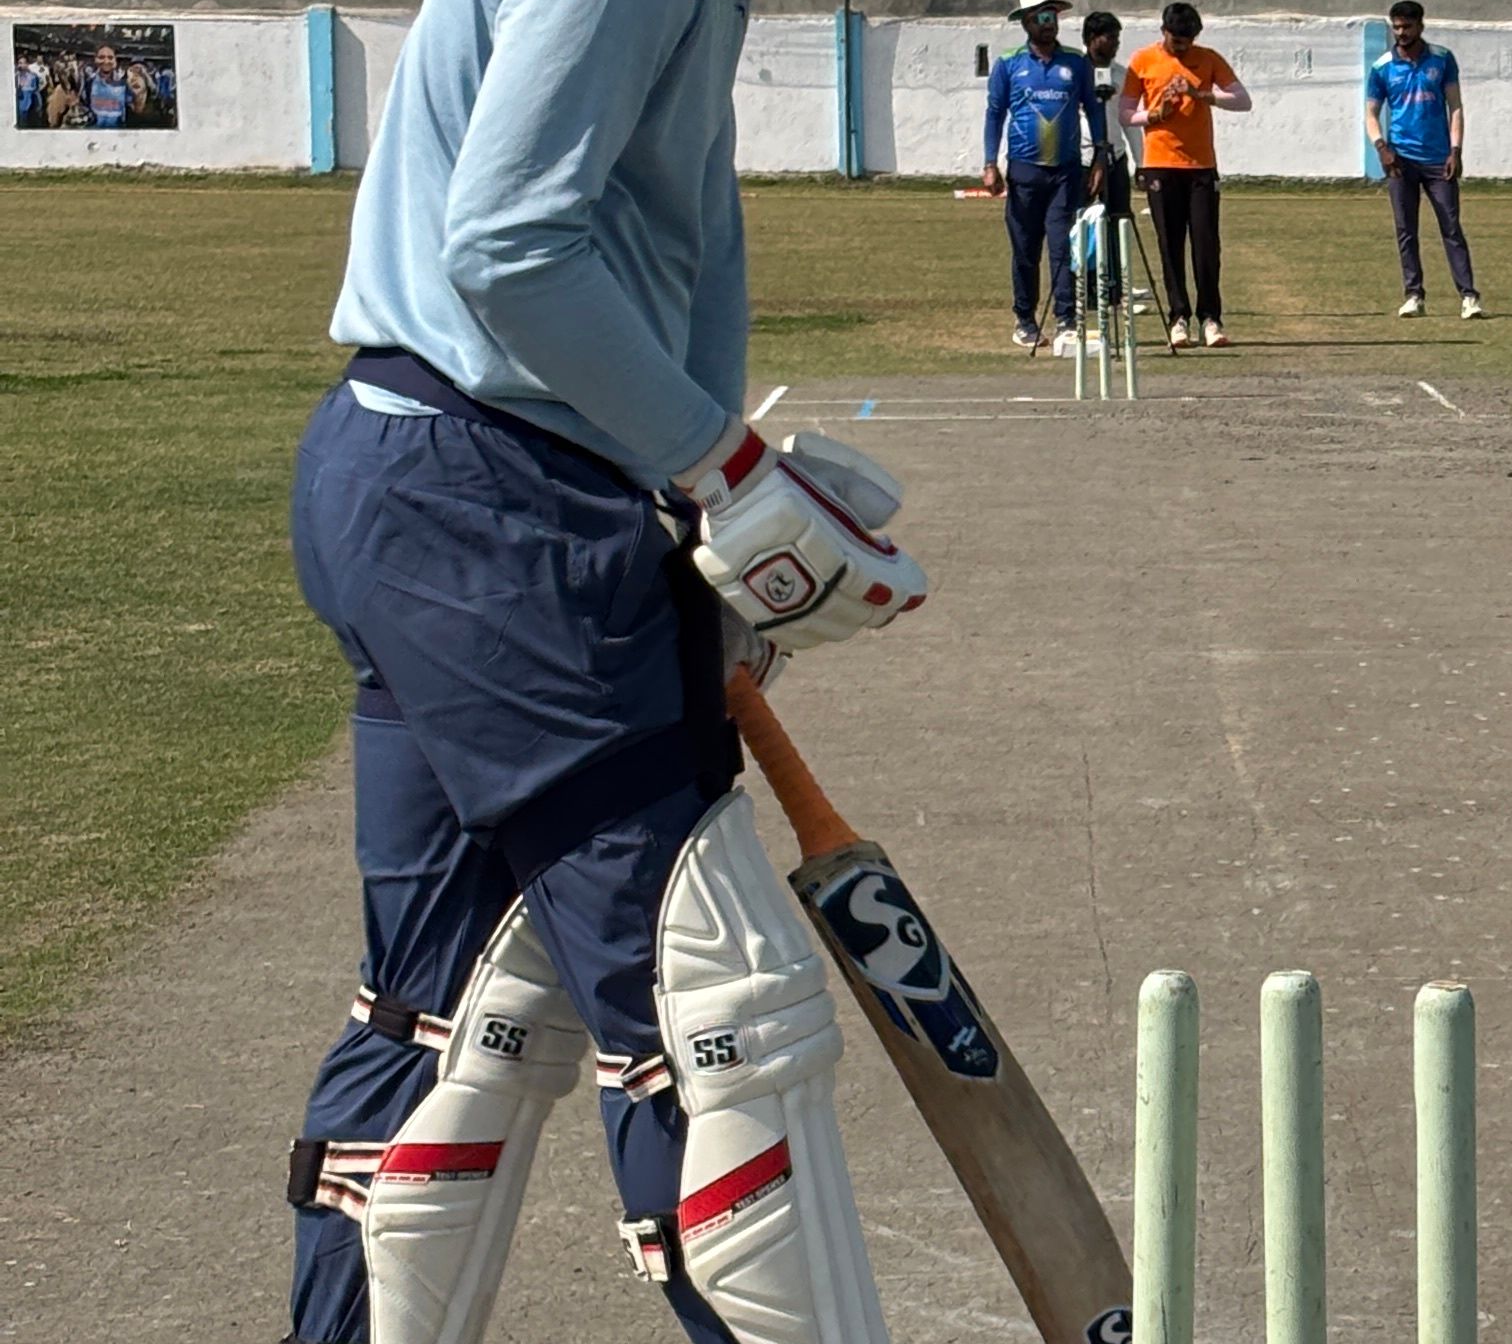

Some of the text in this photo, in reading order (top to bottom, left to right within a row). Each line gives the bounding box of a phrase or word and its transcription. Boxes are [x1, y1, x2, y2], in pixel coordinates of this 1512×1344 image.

[848, 873, 928, 984] SG
[481, 1020, 528, 1055] SS
[693, 1033, 738, 1068] SS
